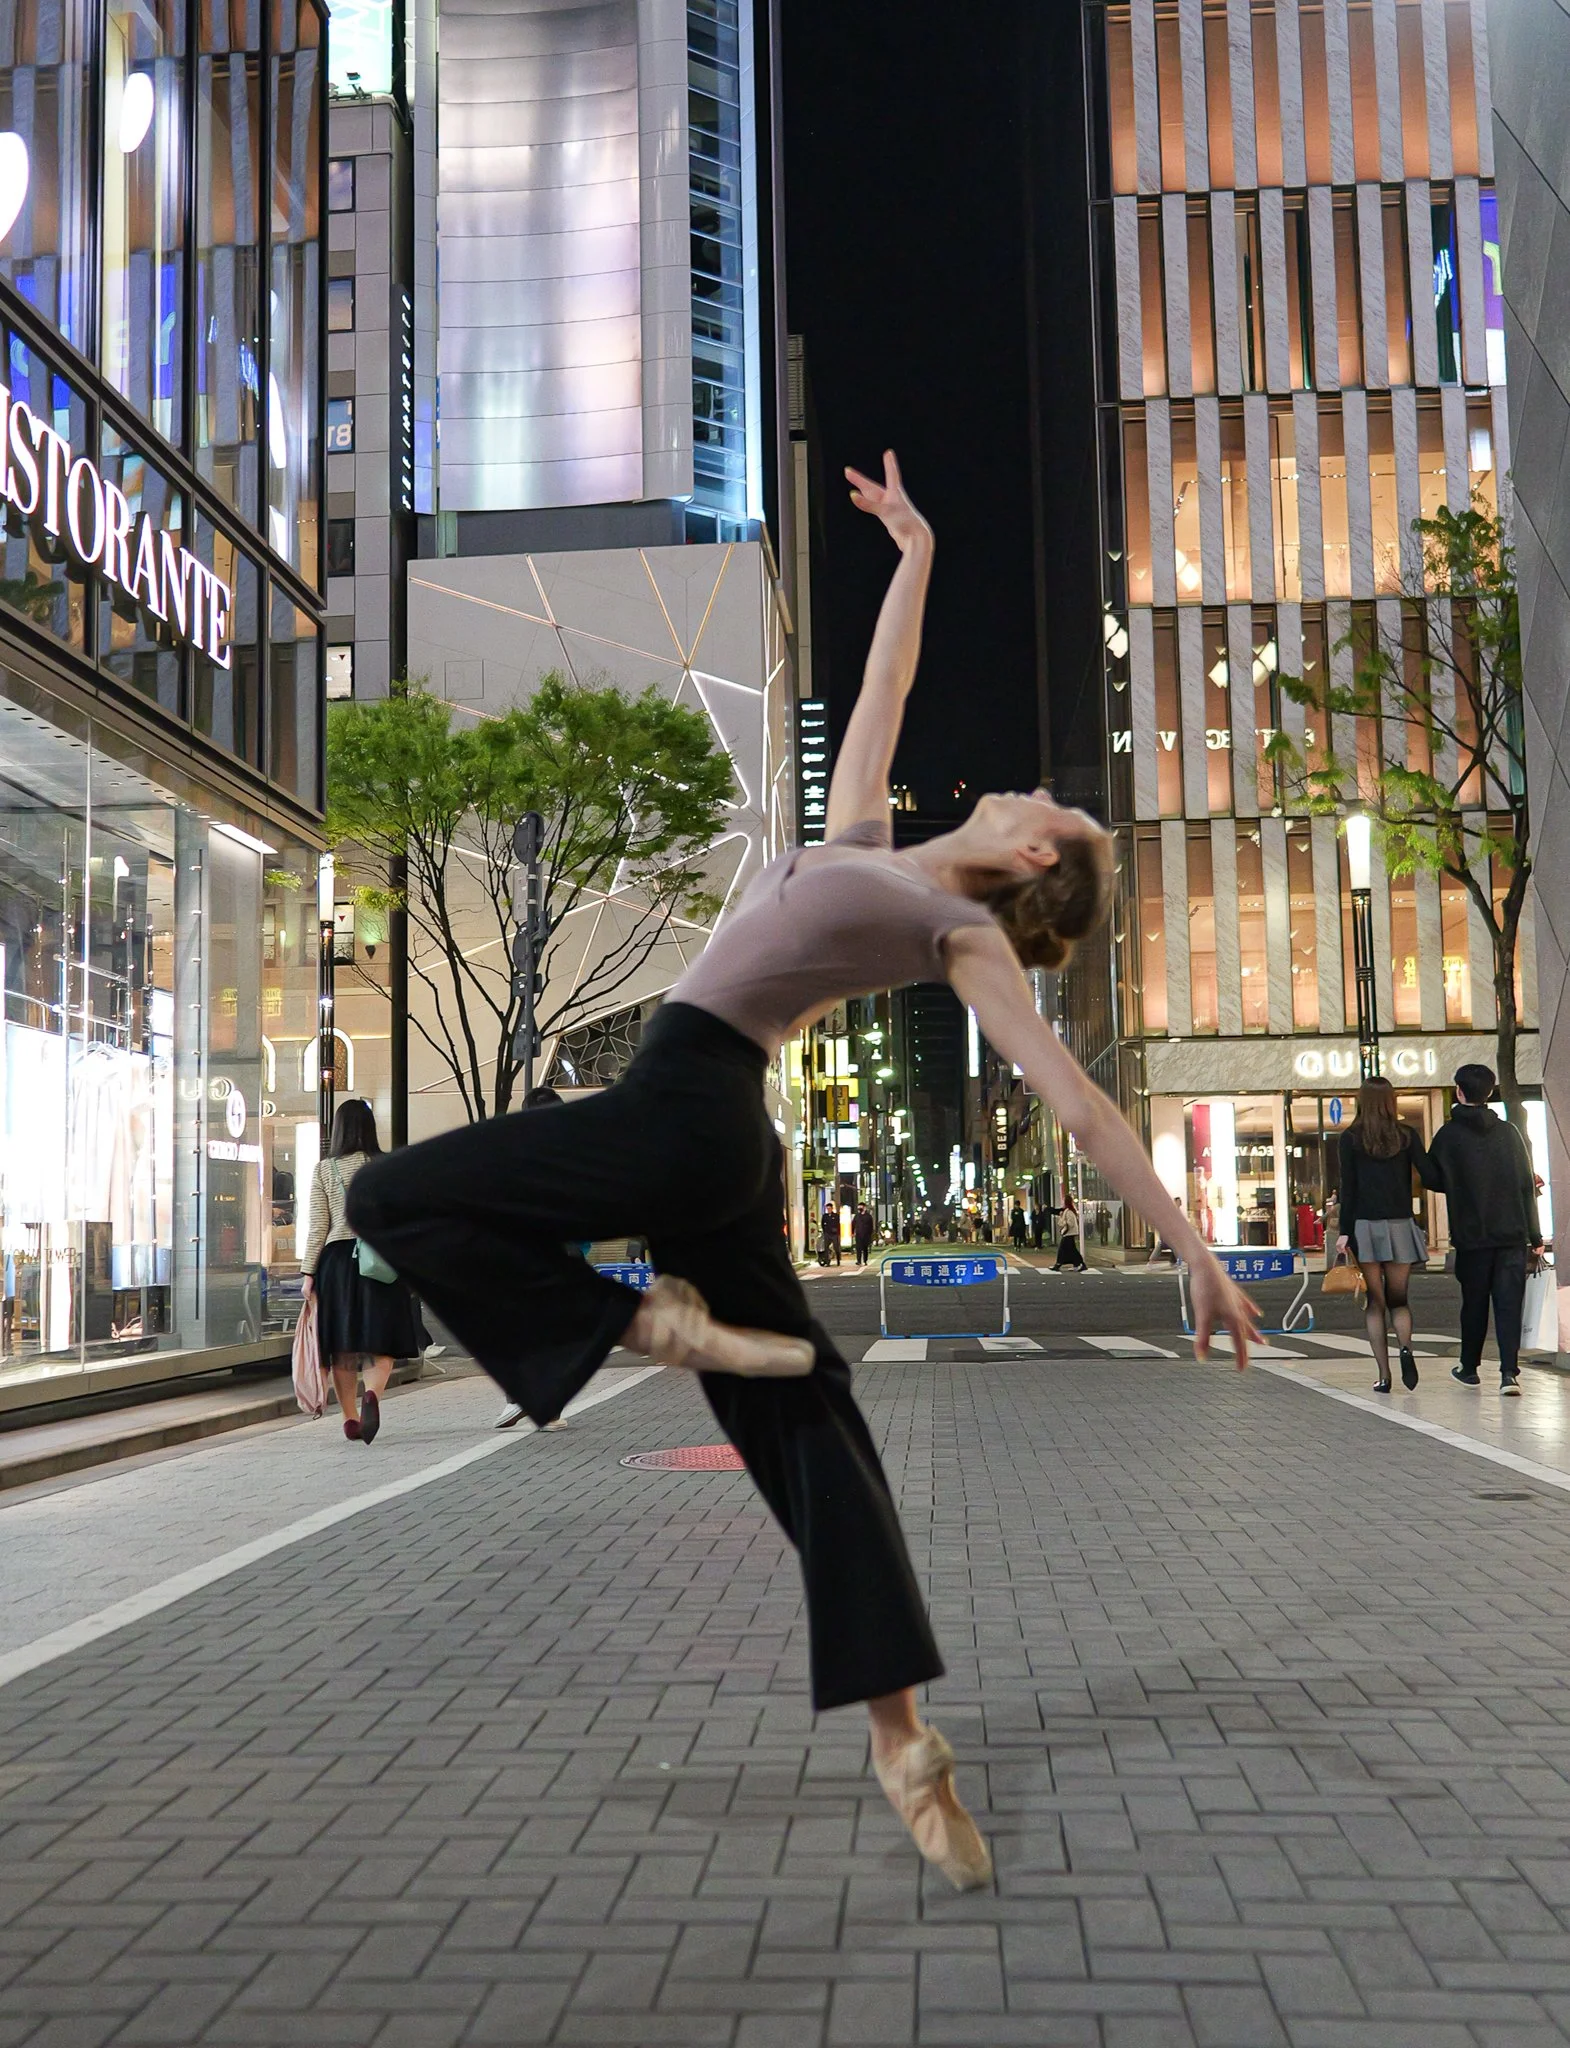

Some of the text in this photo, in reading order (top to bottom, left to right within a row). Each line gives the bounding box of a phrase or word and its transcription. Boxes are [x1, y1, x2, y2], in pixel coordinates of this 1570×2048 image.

[1295, 1048, 1437, 1078] GUCI
[903, 1264, 985, 1278] 車両通行止
